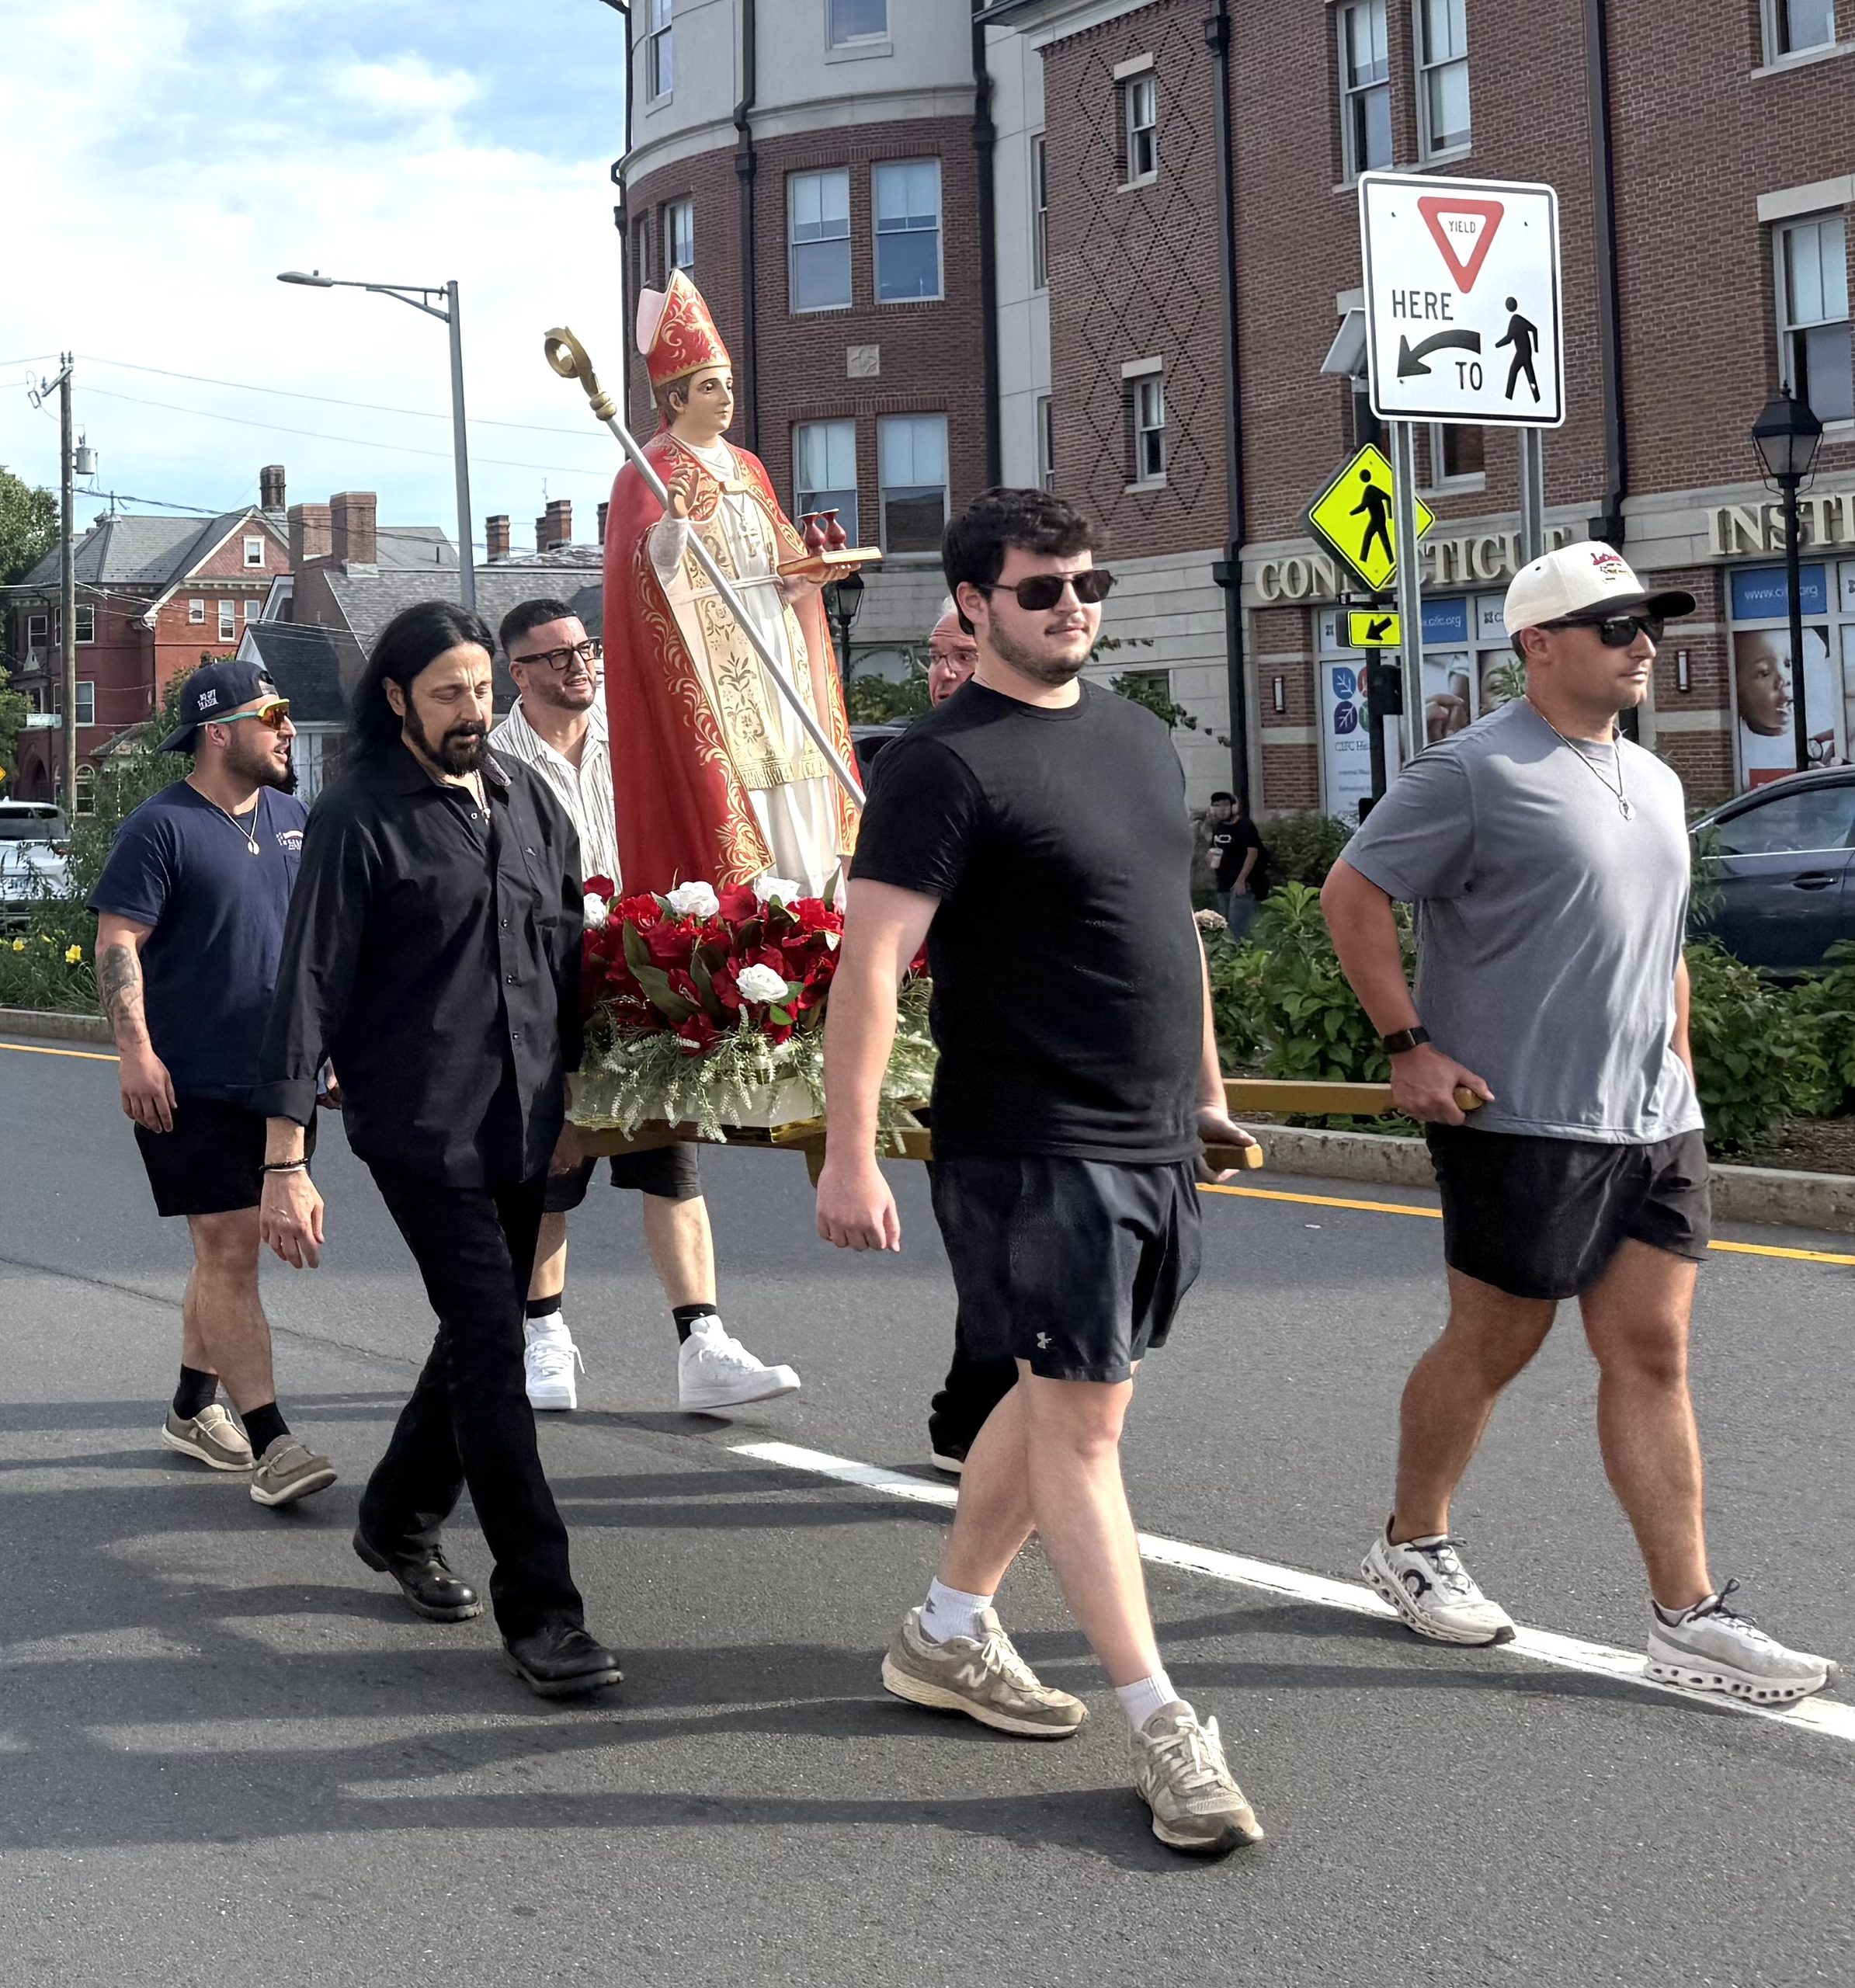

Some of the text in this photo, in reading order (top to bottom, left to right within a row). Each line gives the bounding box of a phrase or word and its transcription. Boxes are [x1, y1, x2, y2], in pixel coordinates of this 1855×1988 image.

[1448, 221, 1476, 234] YIELD
[1392, 290, 1454, 321] HERE
[1455, 362, 1483, 391] TO
[1255, 527, 1569, 601] CONTICUT
